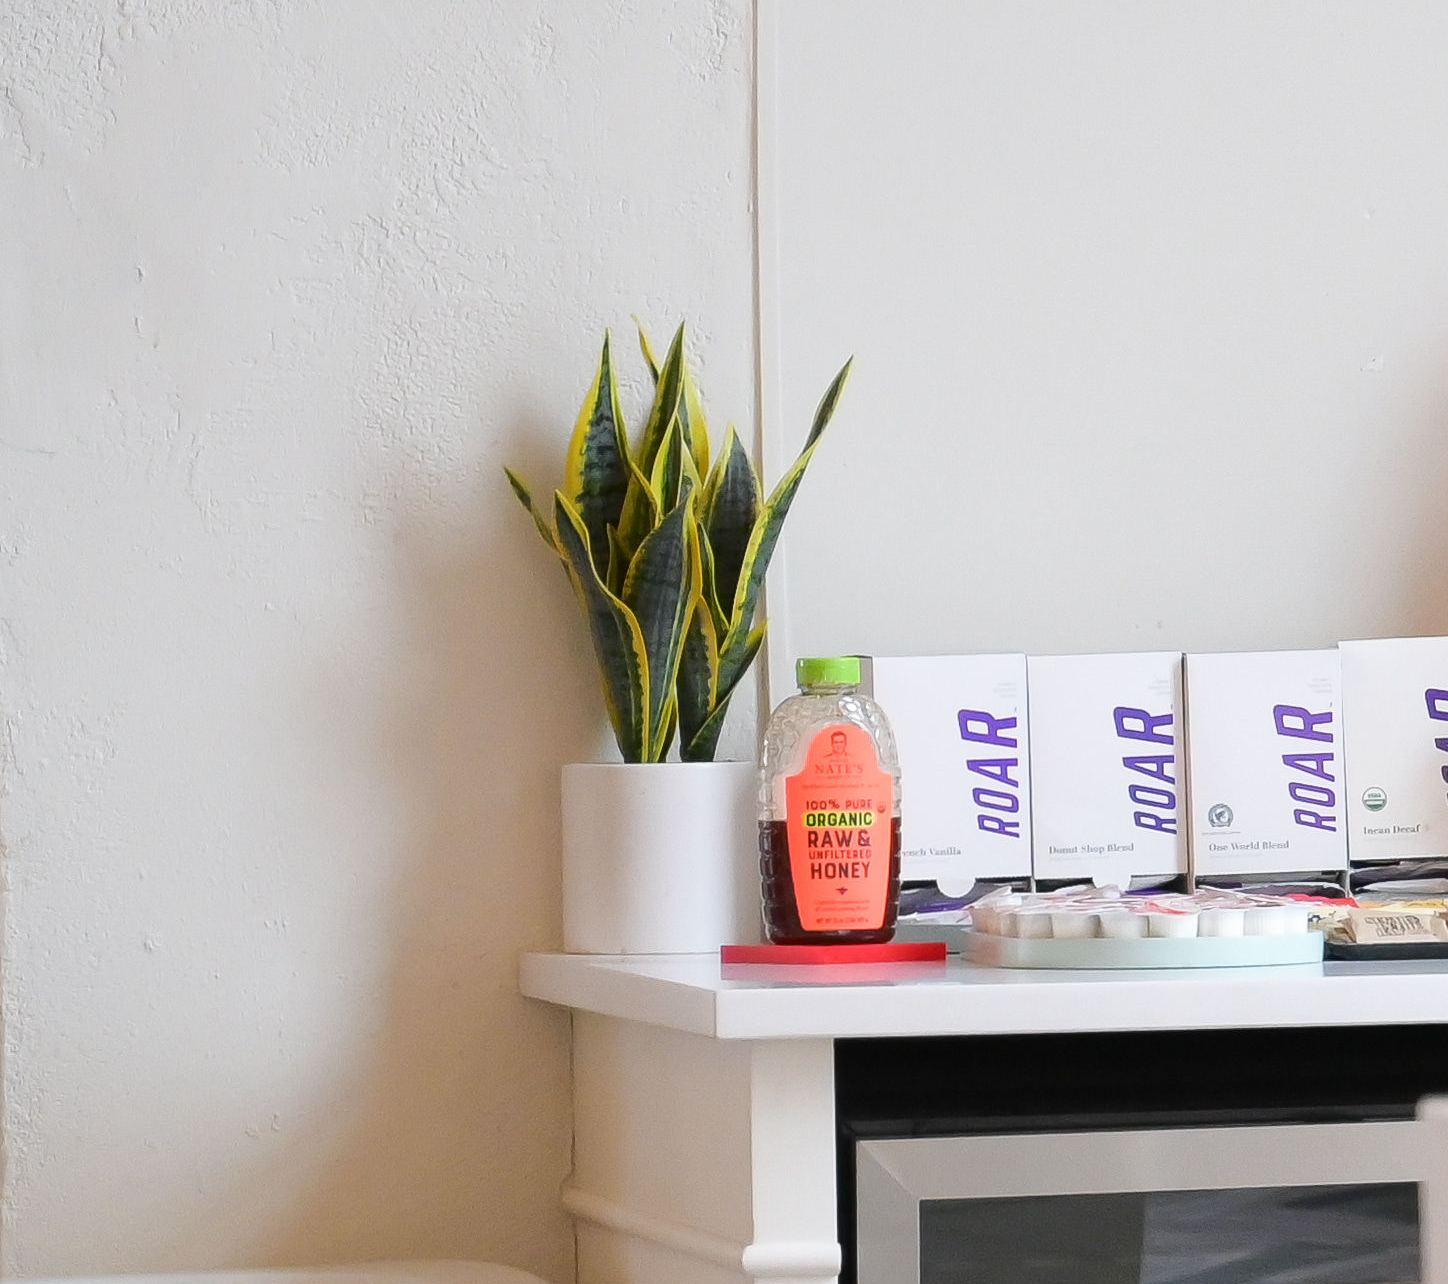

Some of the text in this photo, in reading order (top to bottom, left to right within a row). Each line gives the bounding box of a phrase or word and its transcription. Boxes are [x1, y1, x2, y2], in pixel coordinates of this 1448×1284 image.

[957, 708, 1020, 839] ROAR
[1113, 706, 1178, 835] ROAR
[1272, 704, 1337, 832] ROAR
[806, 798, 873, 812] 100% PURE
[806, 811, 874, 828] ORGANIC
[808, 829, 872, 849] RAW &
[1208, 839, 1290, 852] One World Blend
[808, 848, 873, 861] UNFILTERED
[1080, 844, 1106, 855] Shop
[1106, 842, 1135, 852] Blend
[811, 861, 871, 881] HONEY
